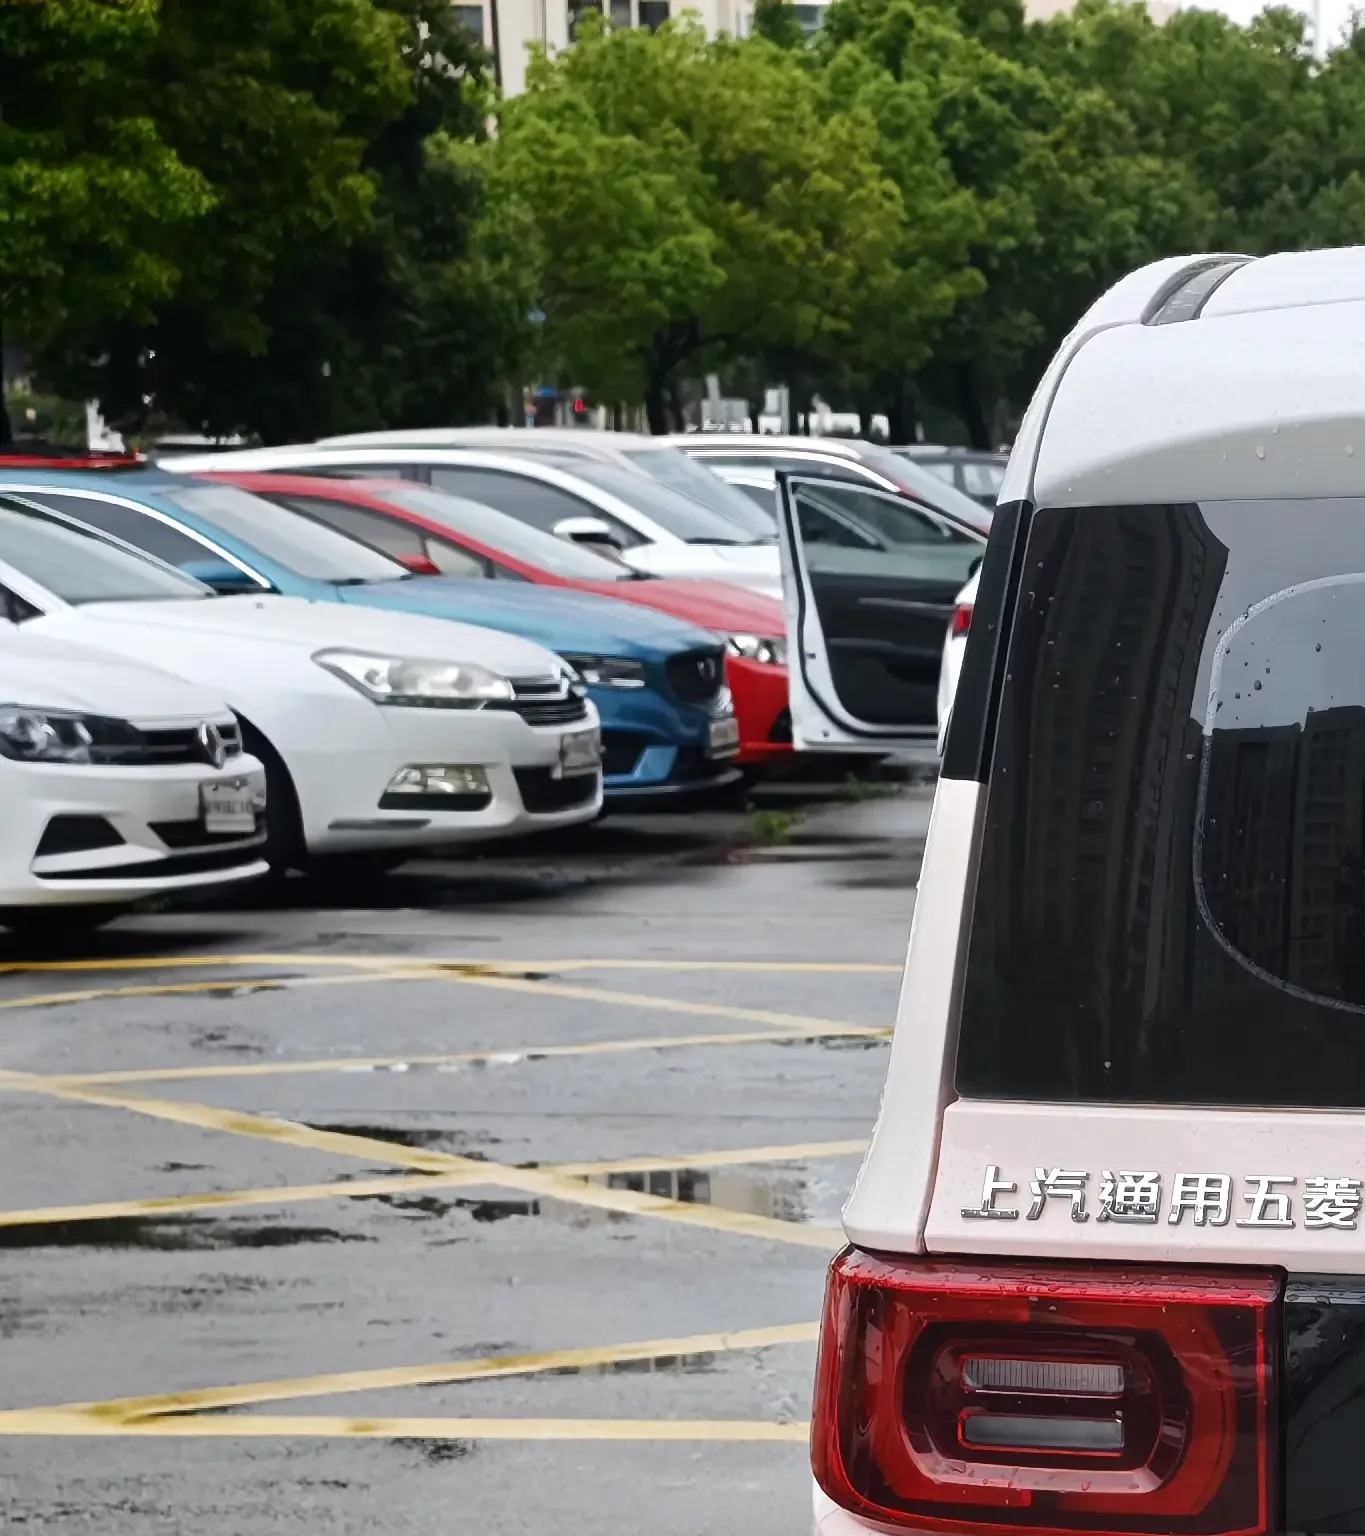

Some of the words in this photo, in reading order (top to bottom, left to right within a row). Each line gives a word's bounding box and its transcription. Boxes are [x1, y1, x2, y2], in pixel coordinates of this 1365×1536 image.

[960, 1164, 1365, 1230] 上汽通用五菱
